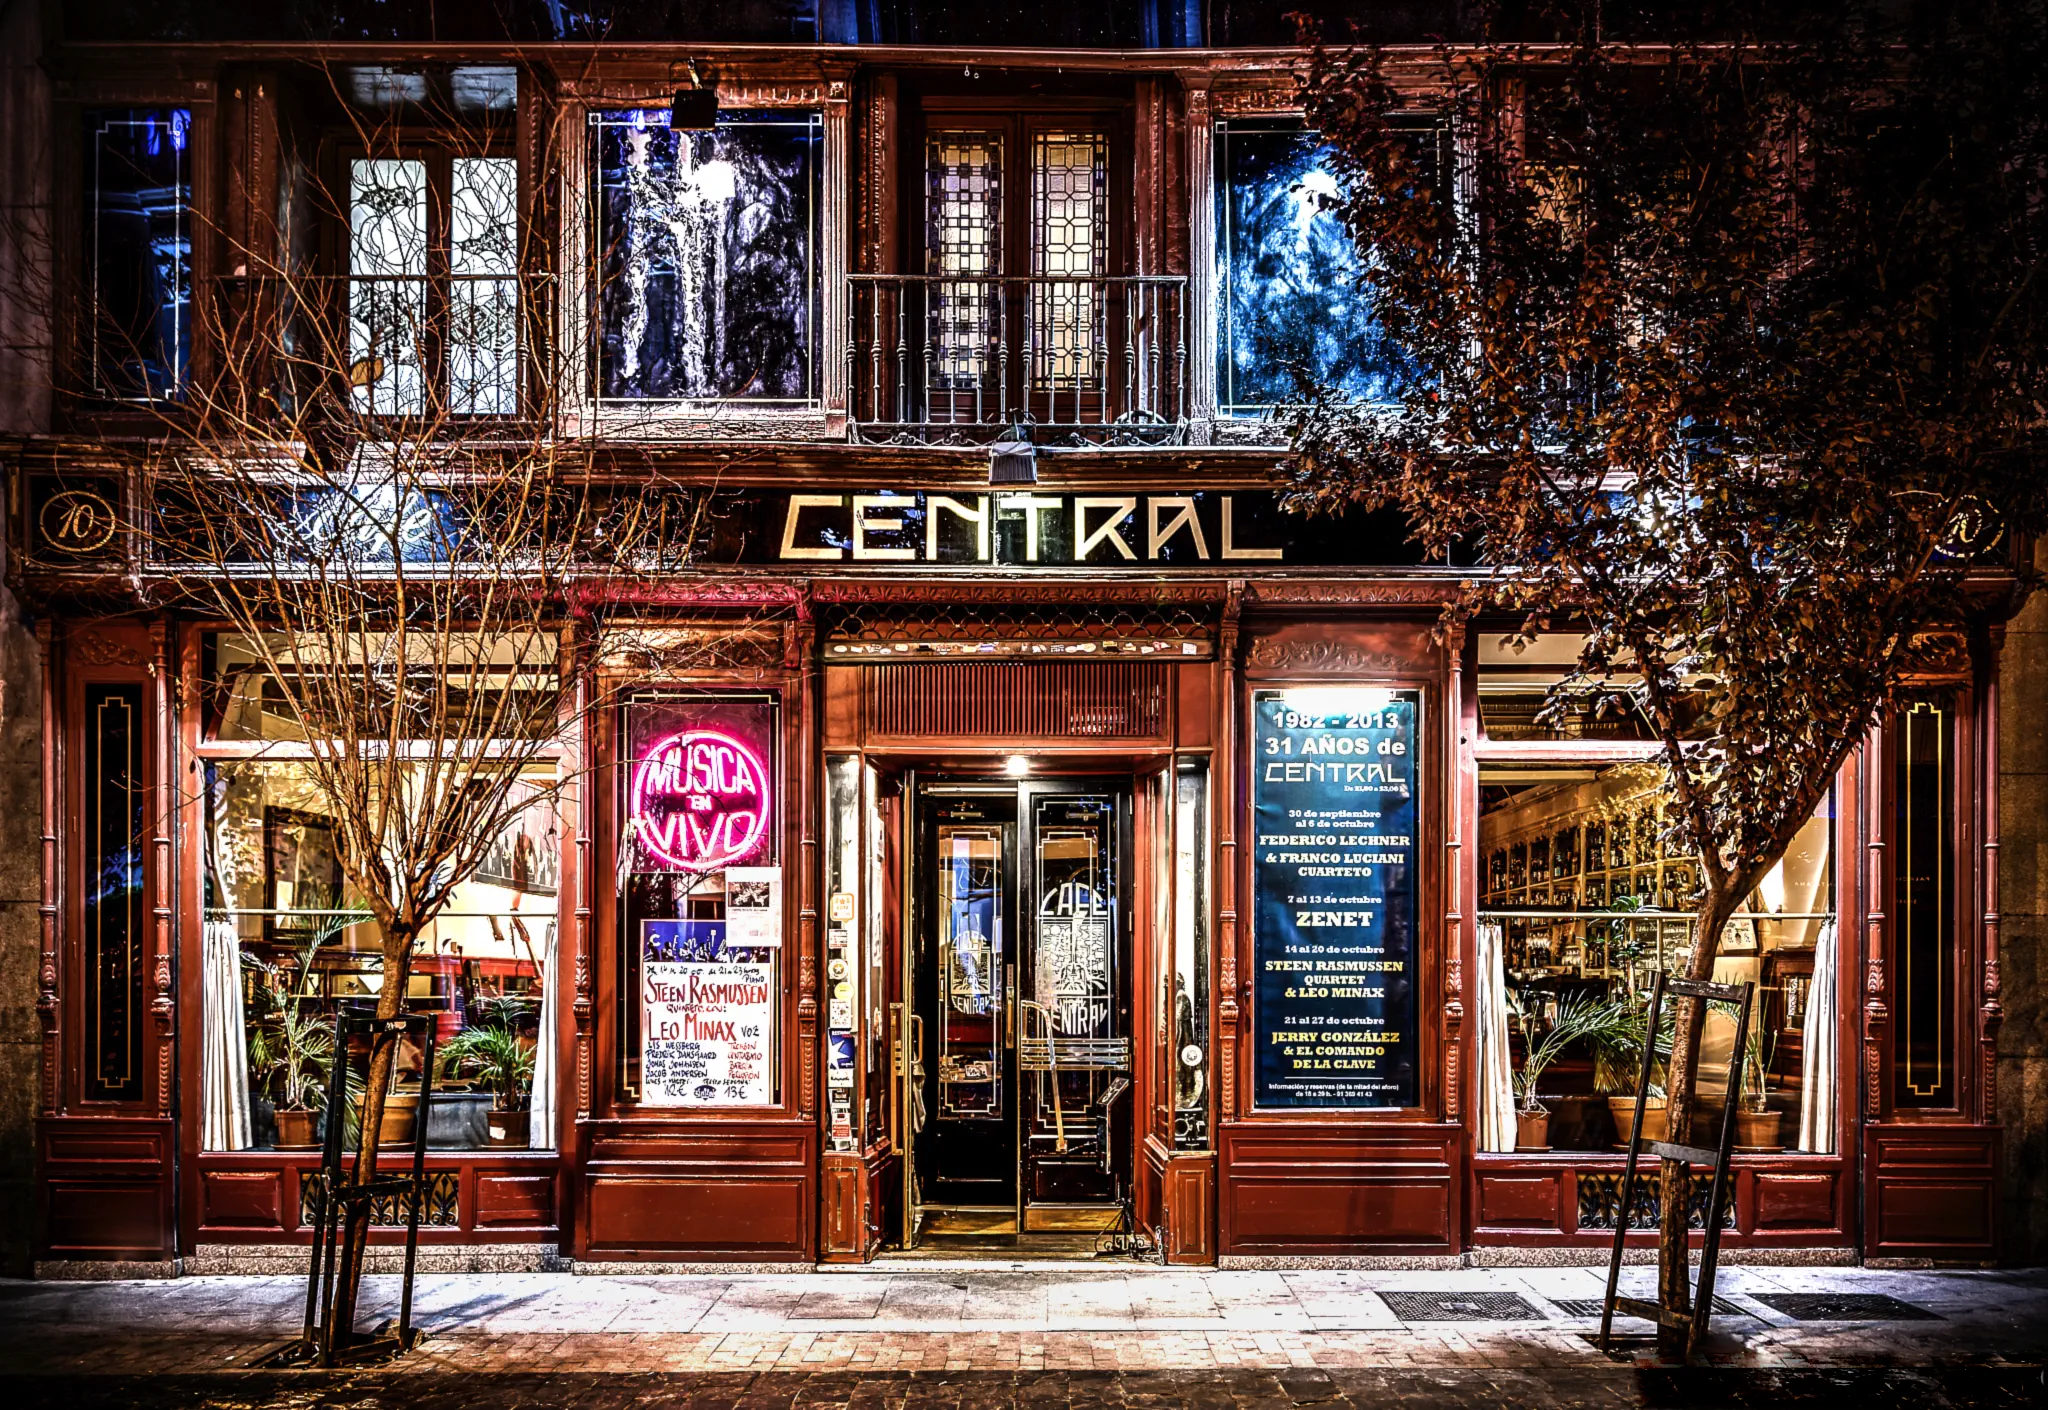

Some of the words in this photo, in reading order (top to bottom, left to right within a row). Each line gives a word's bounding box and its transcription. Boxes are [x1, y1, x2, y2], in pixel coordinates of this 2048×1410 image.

[780, 495, 1283, 561] CENTRAL
[1272, 711, 1326, 729] 1982
[1345, 711, 1398, 729] 2013
[1265, 737, 1292, 755] 31
[1301, 733, 1370, 755] AÑOS
[1376, 737, 1406, 755] de
[1264, 762, 1406, 783] CENTRAL
[1289, 810, 1302, 818] 30
[1304, 810, 1318, 818] de
[1320, 810, 1382, 820] septiembre
[1296, 820, 1306, 828] al
[1308, 820, 1314, 828] 6
[1317, 820, 1330, 828] de
[1333, 820, 1374, 828] octubre
[643, 811, 757, 858] VIVO
[1260, 835, 1336, 846] FEDERICO
[1340, 835, 1410, 846] LECHNER
[1266, 853, 1277, 864] &
[1280, 853, 1340, 864] FRANCO
[1344, 853, 1404, 864] LUCIANI
[1298, 867, 1372, 877] CUARTETO
[1288, 896, 1294, 904] 7
[1296, 896, 1307, 904] al
[1310, 896, 1322, 904] 13
[1324, 896, 1337, 904] de
[1340, 896, 1382, 904] octubre
[1296, 912, 1373, 926] ZENET
[1284, 946, 1297, 954] 14
[1299, 946, 1310, 954] al
[1312, 946, 1324, 954] 20
[1326, 946, 1340, 954] de
[1342, 946, 1384, 954] octubre
[1265, 961, 1312, 971] STEEN
[1316, 961, 1403, 971] RASMUSSEN
[1304, 976, 1365, 986] QUARTET
[644, 974, 686, 1004] STEEN
[689, 975, 768, 1006] RASMUSSEN
[1284, 988, 1296, 998] &
[1299, 988, 1328, 998] LEO
[1332, 988, 1384, 998] MINAX
[1044, 1000, 1108, 1036] ENTRAL
[1284, 1017, 1297, 1025] 21
[1299, 1017, 1310, 1025] al
[1312, 1017, 1324, 1025] 27
[1326, 1017, 1340, 1025] de
[1342, 1017, 1384, 1025] octubre
[648, 1010, 680, 1040] LEO
[684, 1013, 737, 1042] MINAX
[1272, 1032, 1318, 1044] JERRY
[1321, 1030, 1400, 1042] GONZÁLEZ
[1284, 1046, 1294, 1056] &
[1296, 1046, 1314, 1056] EL
[1316, 1046, 1384, 1056] COMANDO
[1293, 1060, 1312, 1069] DE
[1314, 1060, 1331, 1069] LA
[1334, 1060, 1376, 1069] CLAVE
